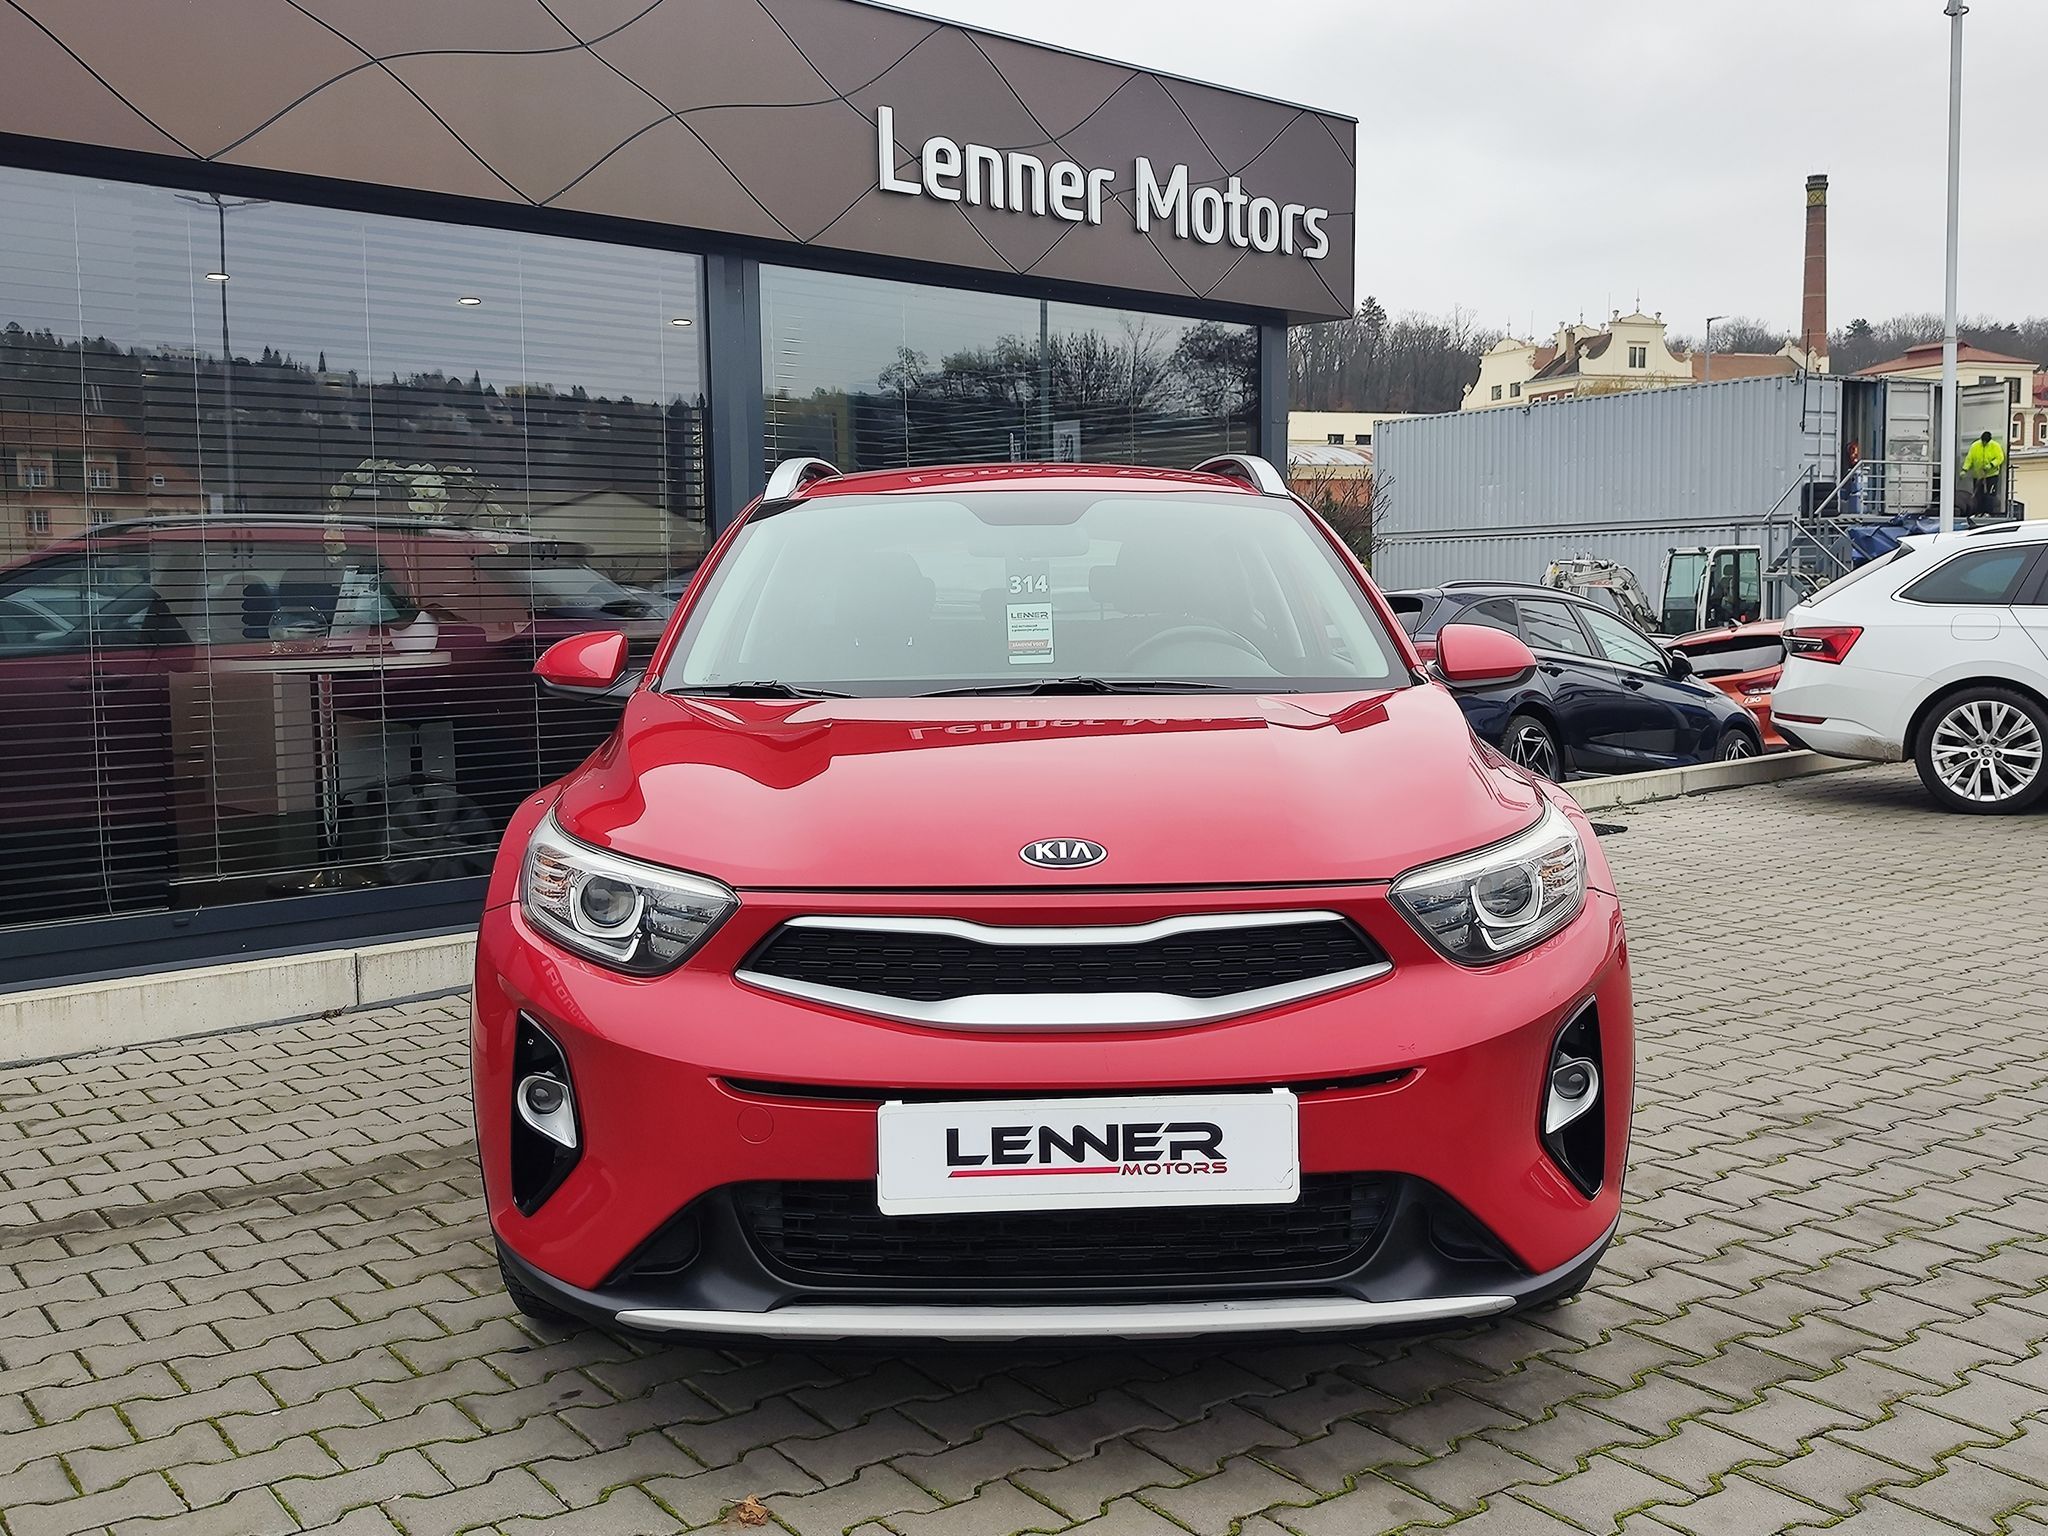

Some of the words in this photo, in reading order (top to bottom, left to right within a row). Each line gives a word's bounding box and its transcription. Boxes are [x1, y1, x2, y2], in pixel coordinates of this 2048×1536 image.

[877, 105, 1116, 225] Lenner
[1134, 157, 1331, 260] Motors
[1008, 574, 1049, 594] 314
[1010, 611, 1049, 620] LENNER
[1034, 840, 1094, 860] KIA
[946, 1121, 1228, 1167] LENNER
[1121, 1160, 1229, 1177] MOTORS
